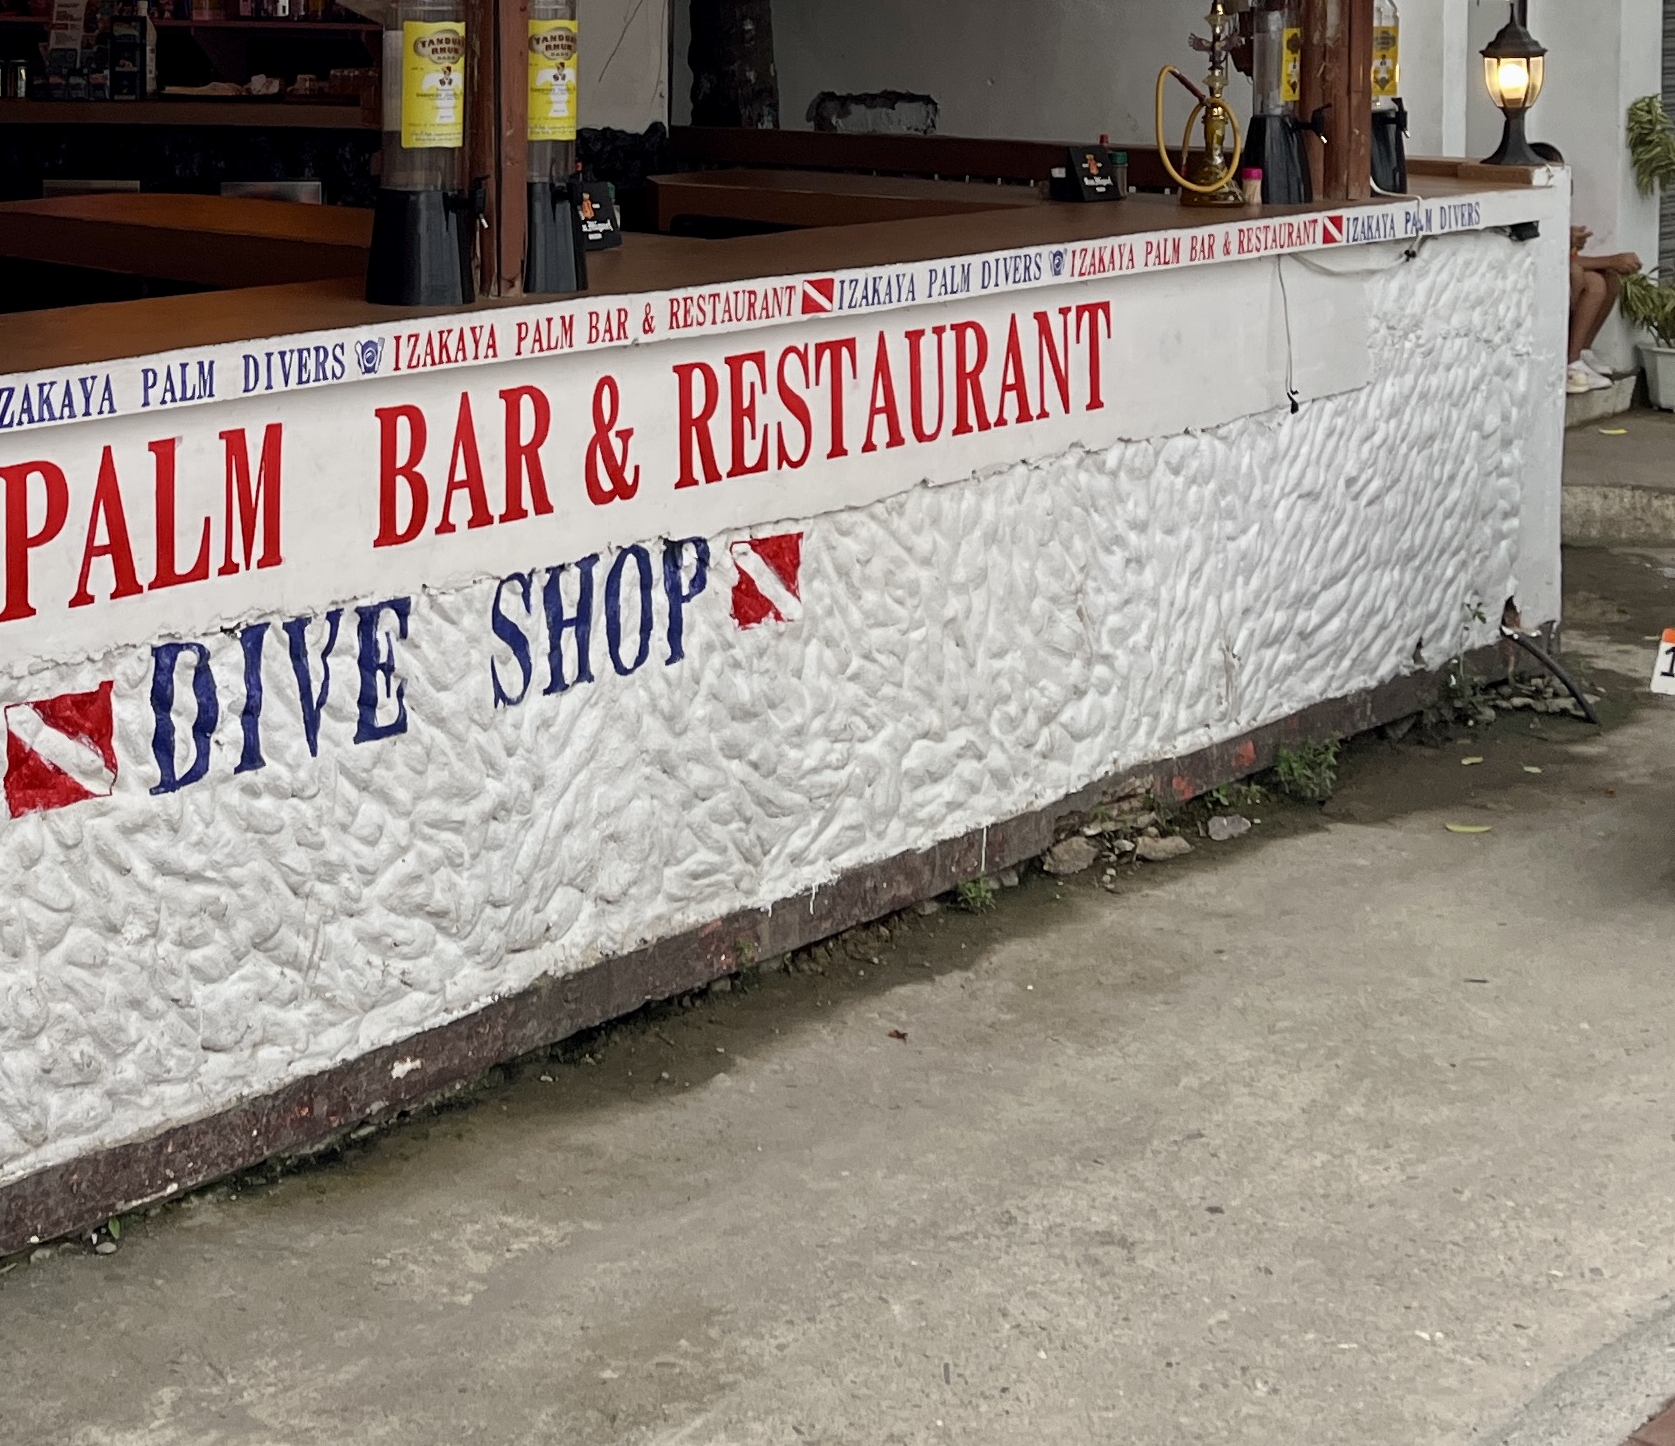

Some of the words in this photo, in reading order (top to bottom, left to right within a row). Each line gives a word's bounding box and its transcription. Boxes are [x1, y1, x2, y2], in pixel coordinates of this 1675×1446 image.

[1069, 242, 1135, 278] IZAKAYA
[1144, 236, 1181, 268] PALM
[1189, 233, 1216, 262] BAR
[1222, 231, 1231, 256] &
[1237, 218, 1319, 255] RESTAURANT
[1345, 213, 1397, 244] IZAKAYA
[1440, 202, 1481, 231] DIVERS
[837, 271, 917, 311] IZAKAYA
[927, 262, 973, 299] PALM
[981, 252, 1043, 290] DIVERS
[393, 322, 498, 372] IZAKAYA
[515, 313, 574, 356] PALM
[587, 307, 629, 345] BAR
[641, 302, 657, 336] &
[667, 285, 797, 331] RESTAURANT
[141, 359, 216, 407] PALM
[242, 342, 346, 394] DIVERS
[372, 384, 554, 548] BAR
[584, 375, 640, 507] &
[674, 300, 1112, 489] RESTAURANT
[148, 596, 412, 796] DIVE
[491, 536, 709, 709] SHOP
